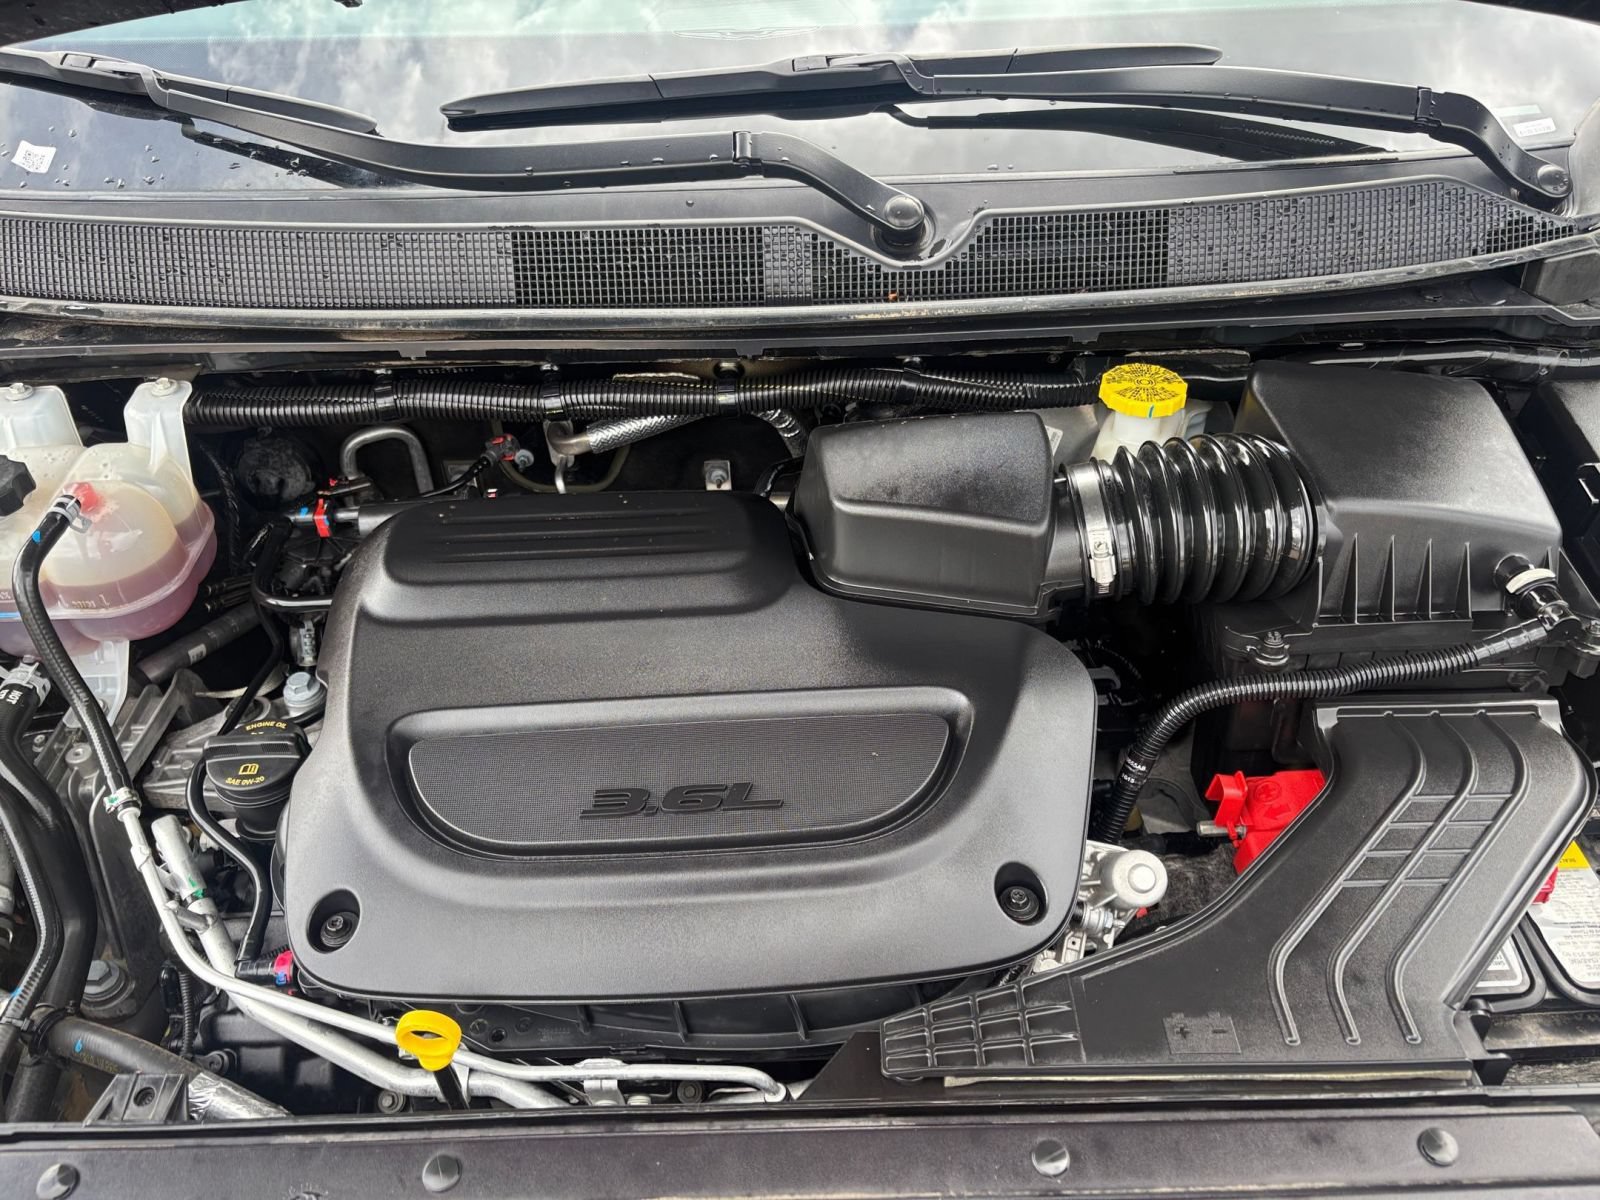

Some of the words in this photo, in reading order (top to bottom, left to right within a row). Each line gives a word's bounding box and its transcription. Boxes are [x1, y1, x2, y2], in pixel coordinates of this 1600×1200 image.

[6, 689, 24, 705] HOT
[245, 721, 275, 731] ENGINE
[275, 721, 288, 729] OIL
[225, 777, 241, 786] SAE
[241, 775, 265, 786] 0W-20
[579, 783, 784, 819] 3.6L
